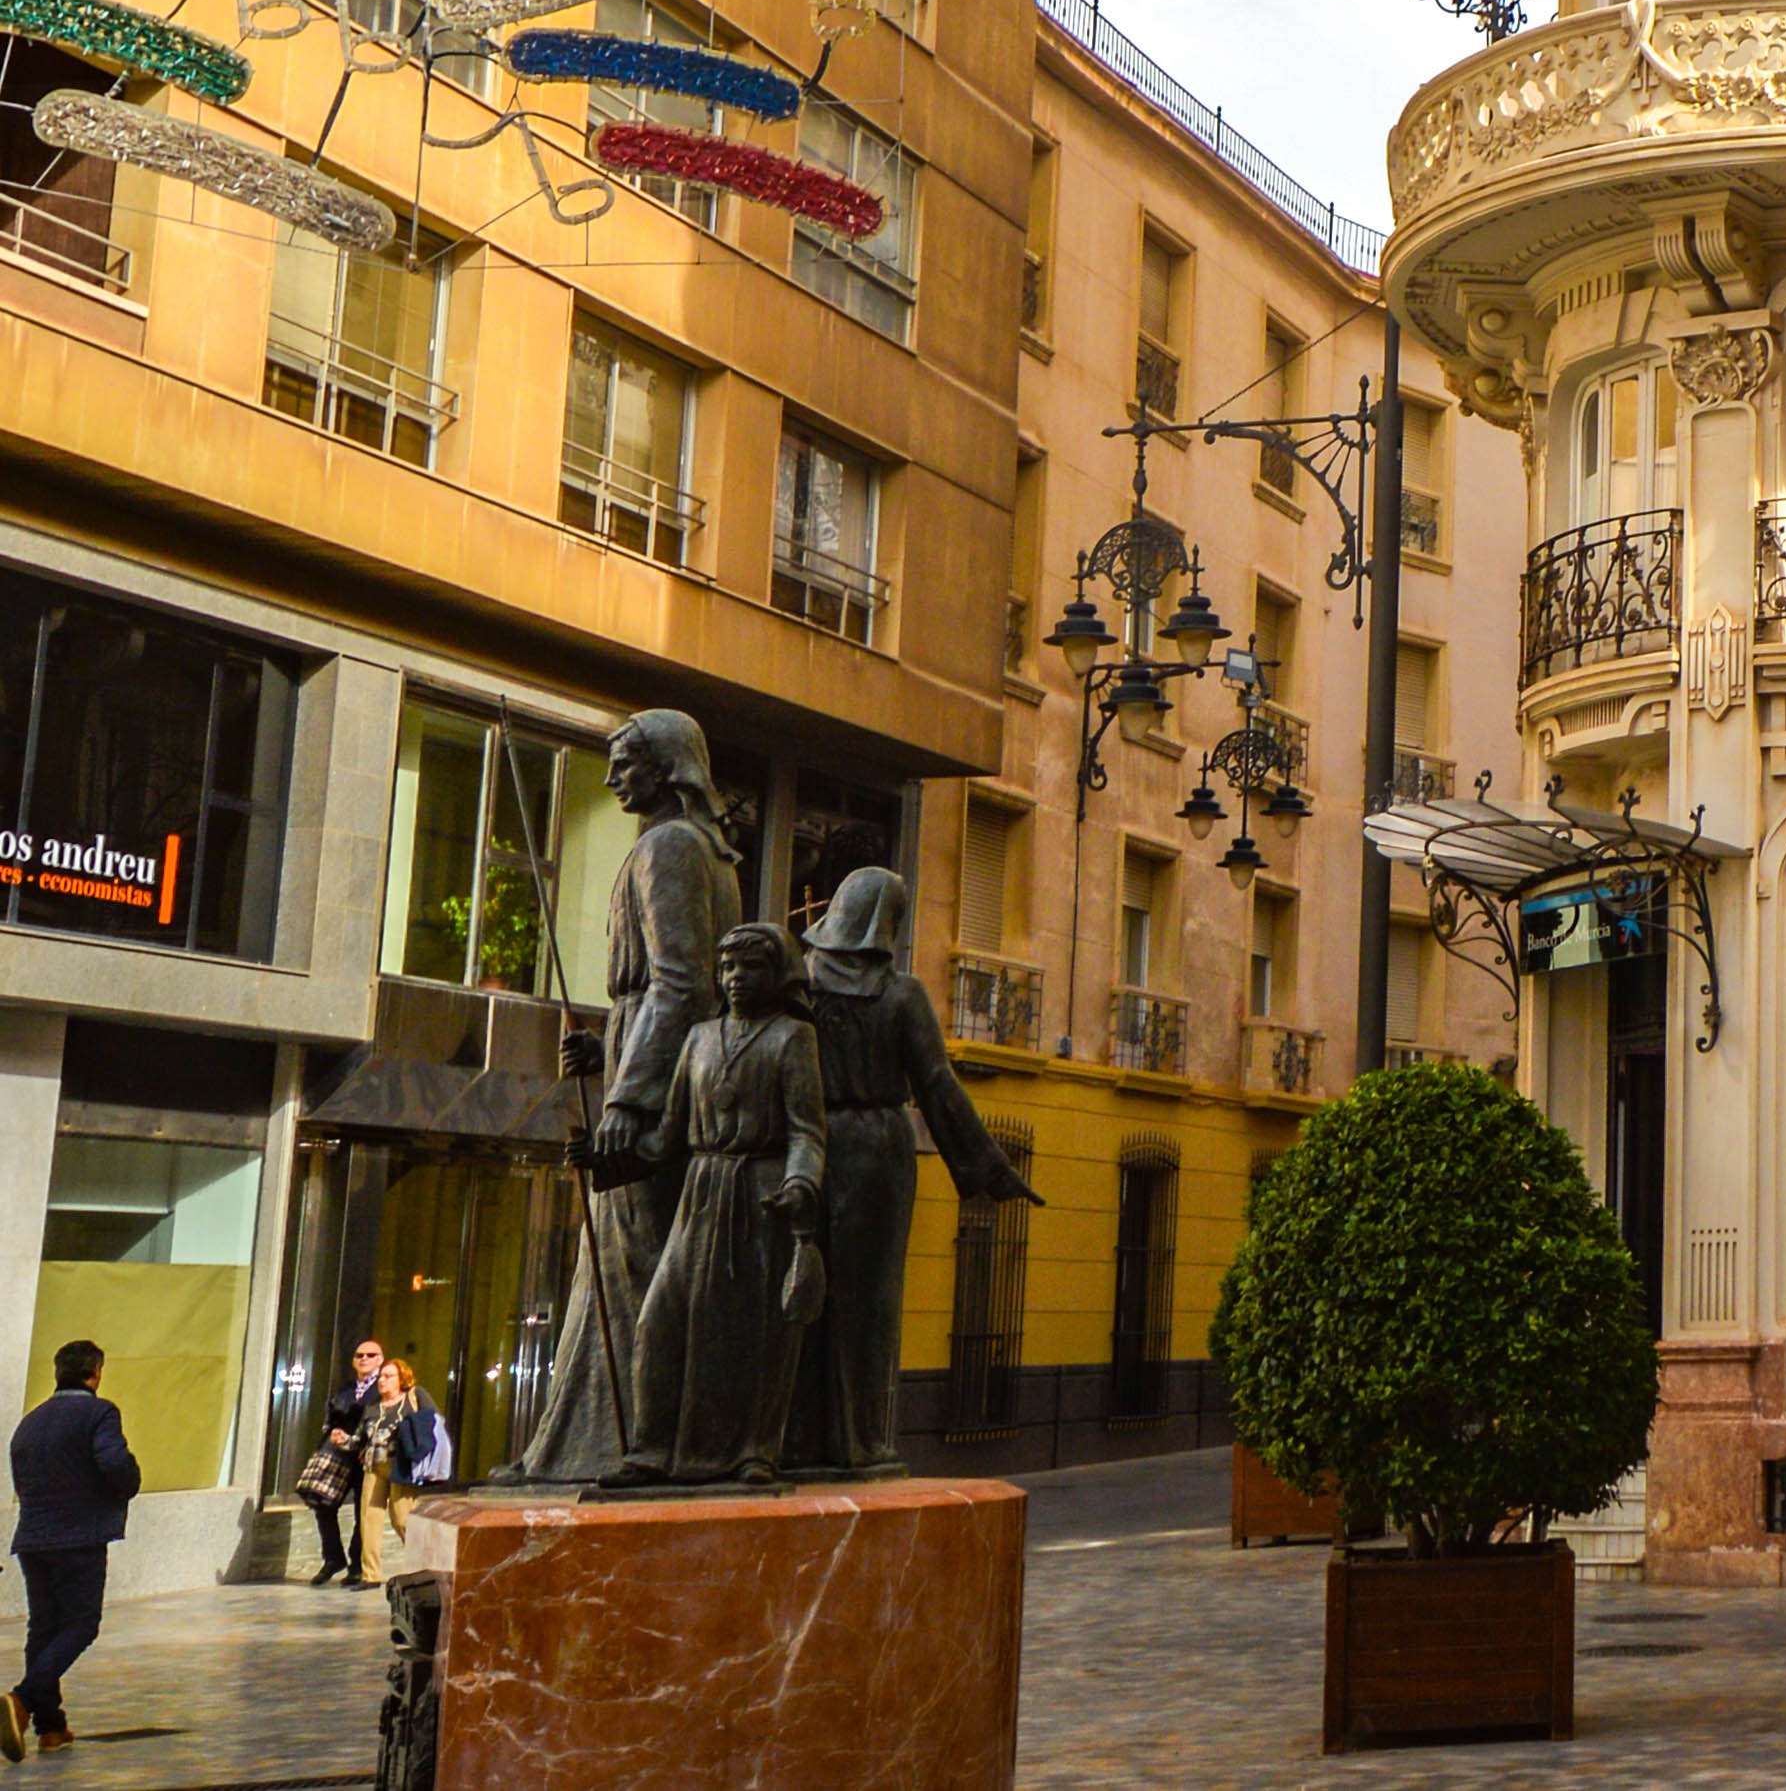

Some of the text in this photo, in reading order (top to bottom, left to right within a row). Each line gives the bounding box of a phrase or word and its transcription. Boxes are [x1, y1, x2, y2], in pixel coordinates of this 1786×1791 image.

[41, 834, 157, 885] andreu
[39, 872, 152, 907] economistas
[1527, 933, 1557, 952] Banco
[1575, 923, 1611, 943] Murcia
